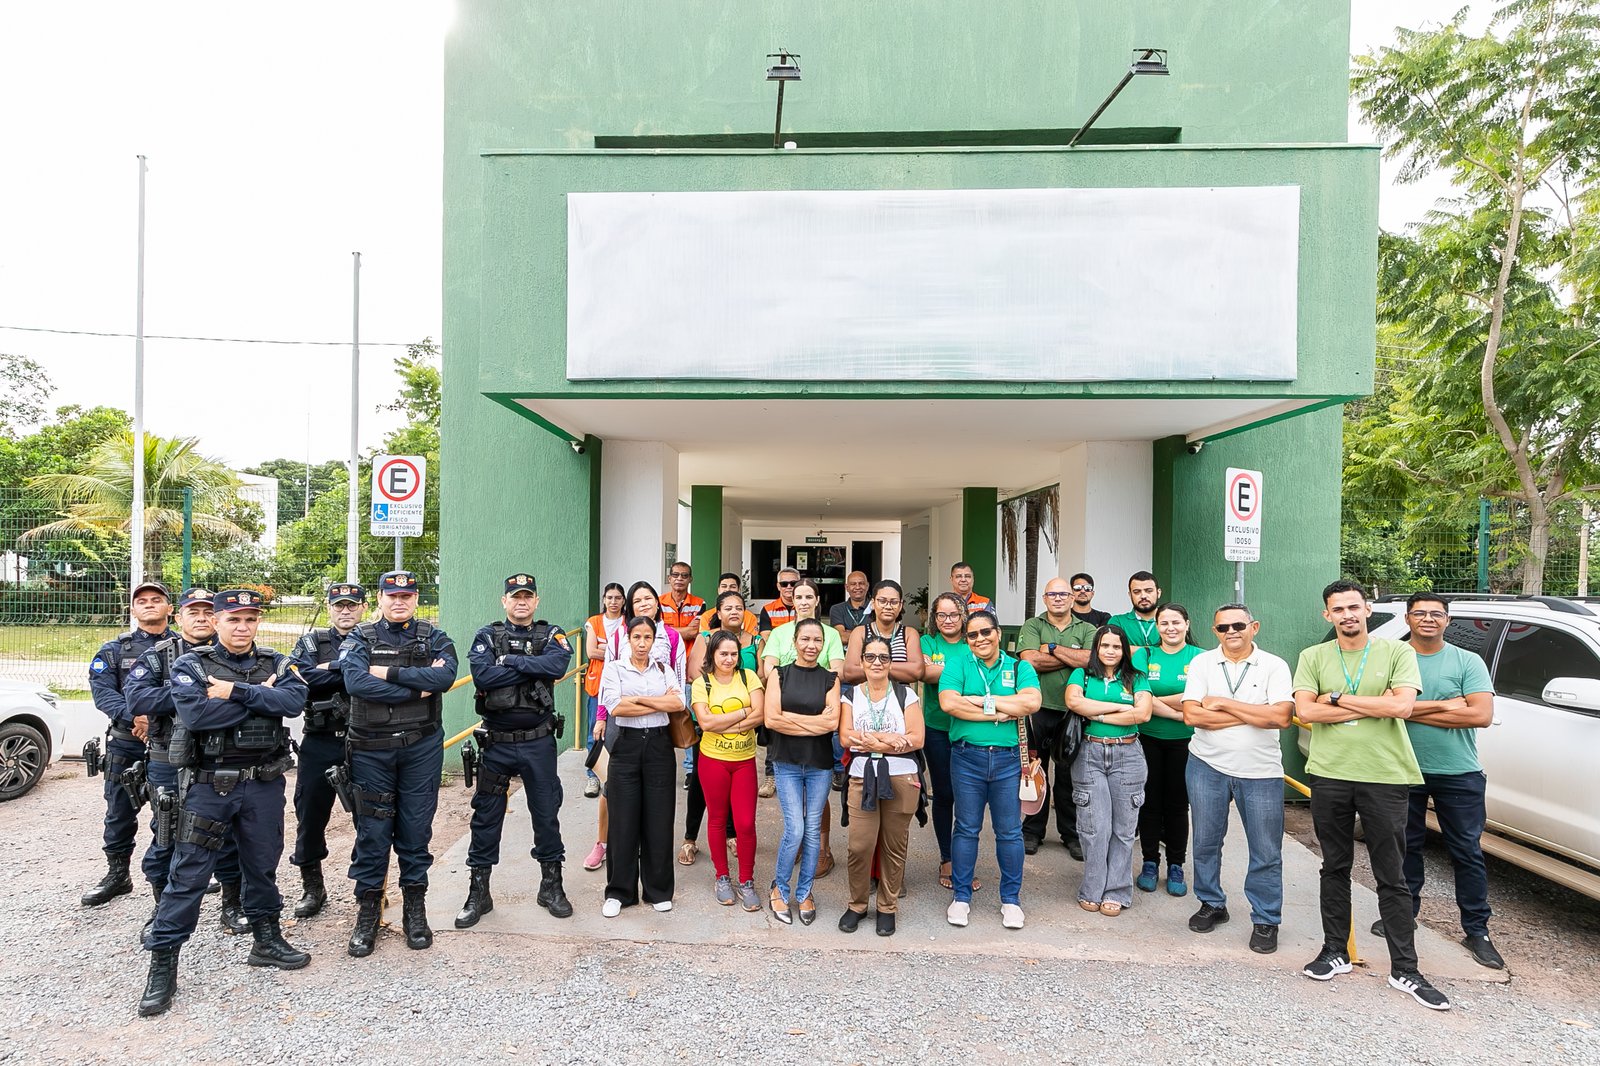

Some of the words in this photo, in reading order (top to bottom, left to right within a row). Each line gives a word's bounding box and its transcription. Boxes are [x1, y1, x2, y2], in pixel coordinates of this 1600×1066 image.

[390, 468, 408, 493] E
[1238, 483, 1250, 512] E
[1227, 525, 1259, 534] EXCLUSIVO
[1234, 537, 1252, 545] IDOSO
